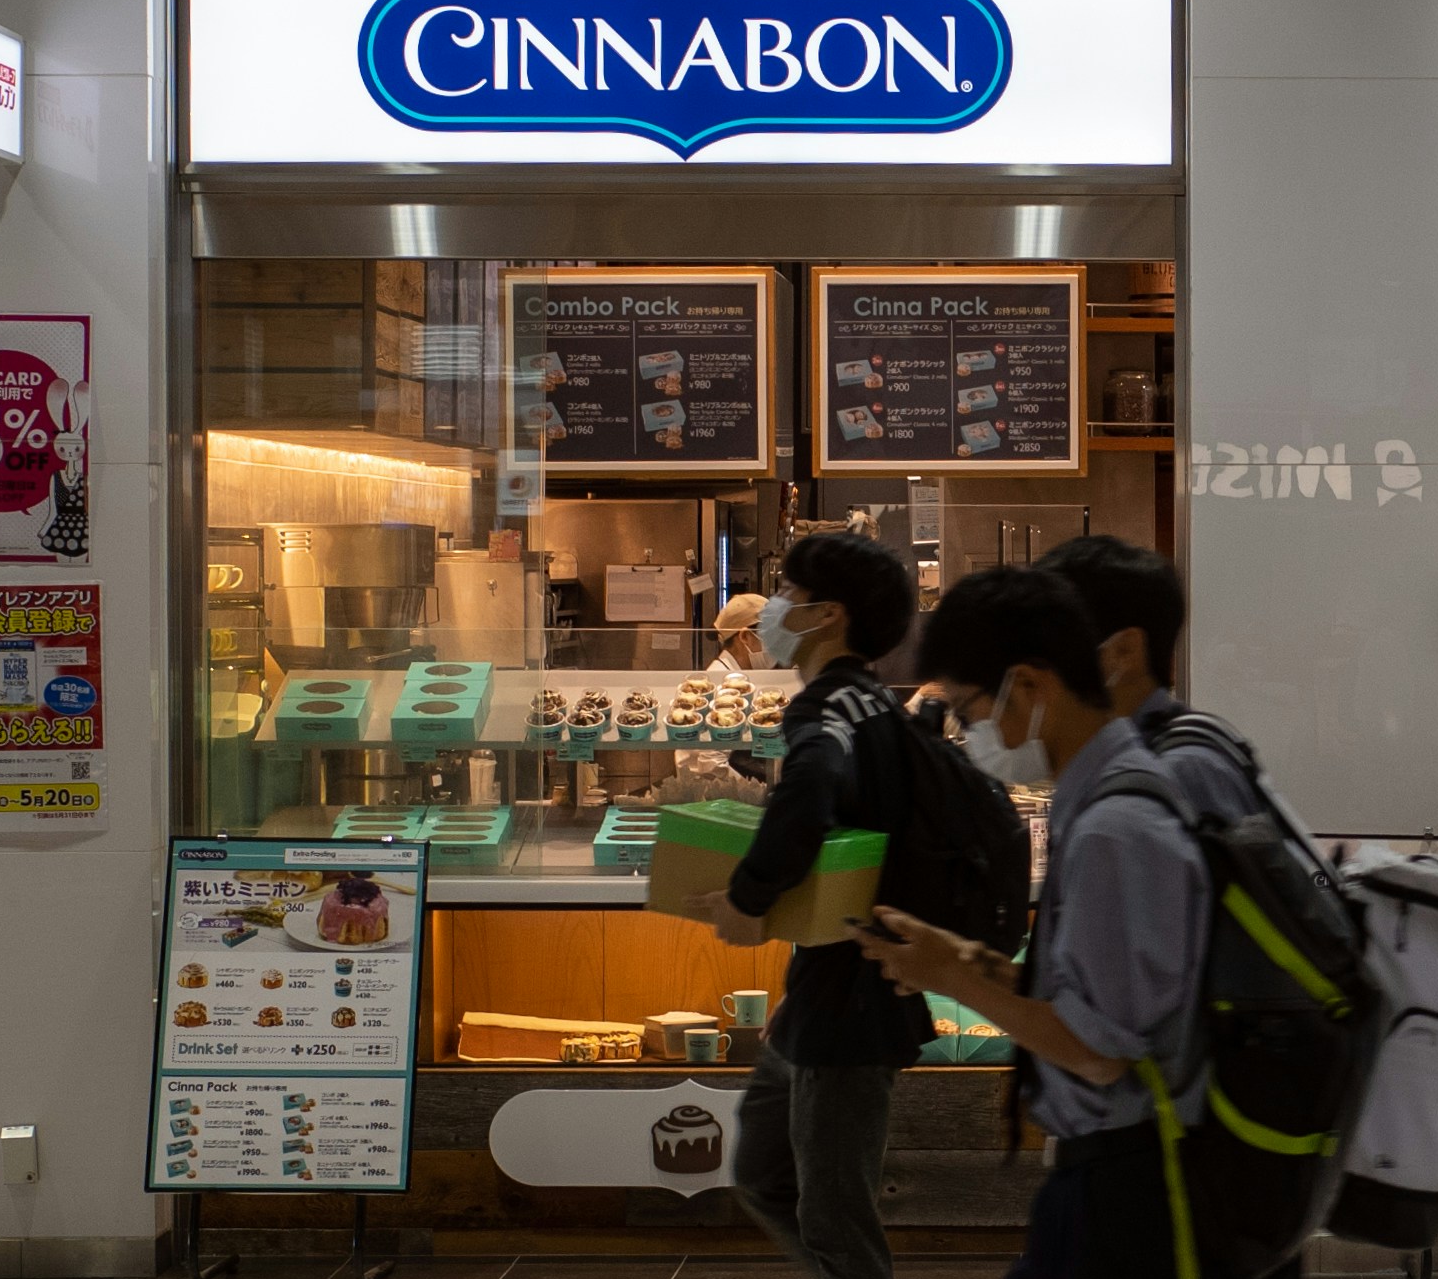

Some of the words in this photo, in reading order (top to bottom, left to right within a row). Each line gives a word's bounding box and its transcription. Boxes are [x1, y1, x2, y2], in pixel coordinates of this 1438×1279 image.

[404, 5, 961, 96] CINNABON
[525, 296, 614, 316] Combo
[621, 296, 680, 316] Pack
[686, 306, 743, 316] お持ち帰り専用
[853, 296, 922, 316] Cinna
[930, 296, 989, 316] Pack
[994, 306, 1050, 316] お持ち帰り専用
[1010, 367, 1032, 377] ¥950
[888, 382, 910, 392] ¥900
[1014, 404, 1040, 414] ¥1900
[568, 425, 594, 435] ¥1960
[690, 428, 715, 438] ¥1960
[889, 429, 914, 439] ¥1800
[1014, 443, 1041, 453] ¥2850
[5, 451, 49, 471] OFF
[59, 692, 79, 702] 限定
[179, 849, 225, 860] CINNABON
[183, 880, 307, 899] 紫いもミニボン
[280, 903, 305, 913] ¥360
[178, 1043, 214, 1055] Drink
[216, 1043, 239, 1055] Set
[306, 1044, 336, 1056] ¥250
[168, 1081, 204, 1093] Cinna
[207, 1081, 238, 1092] Pack
